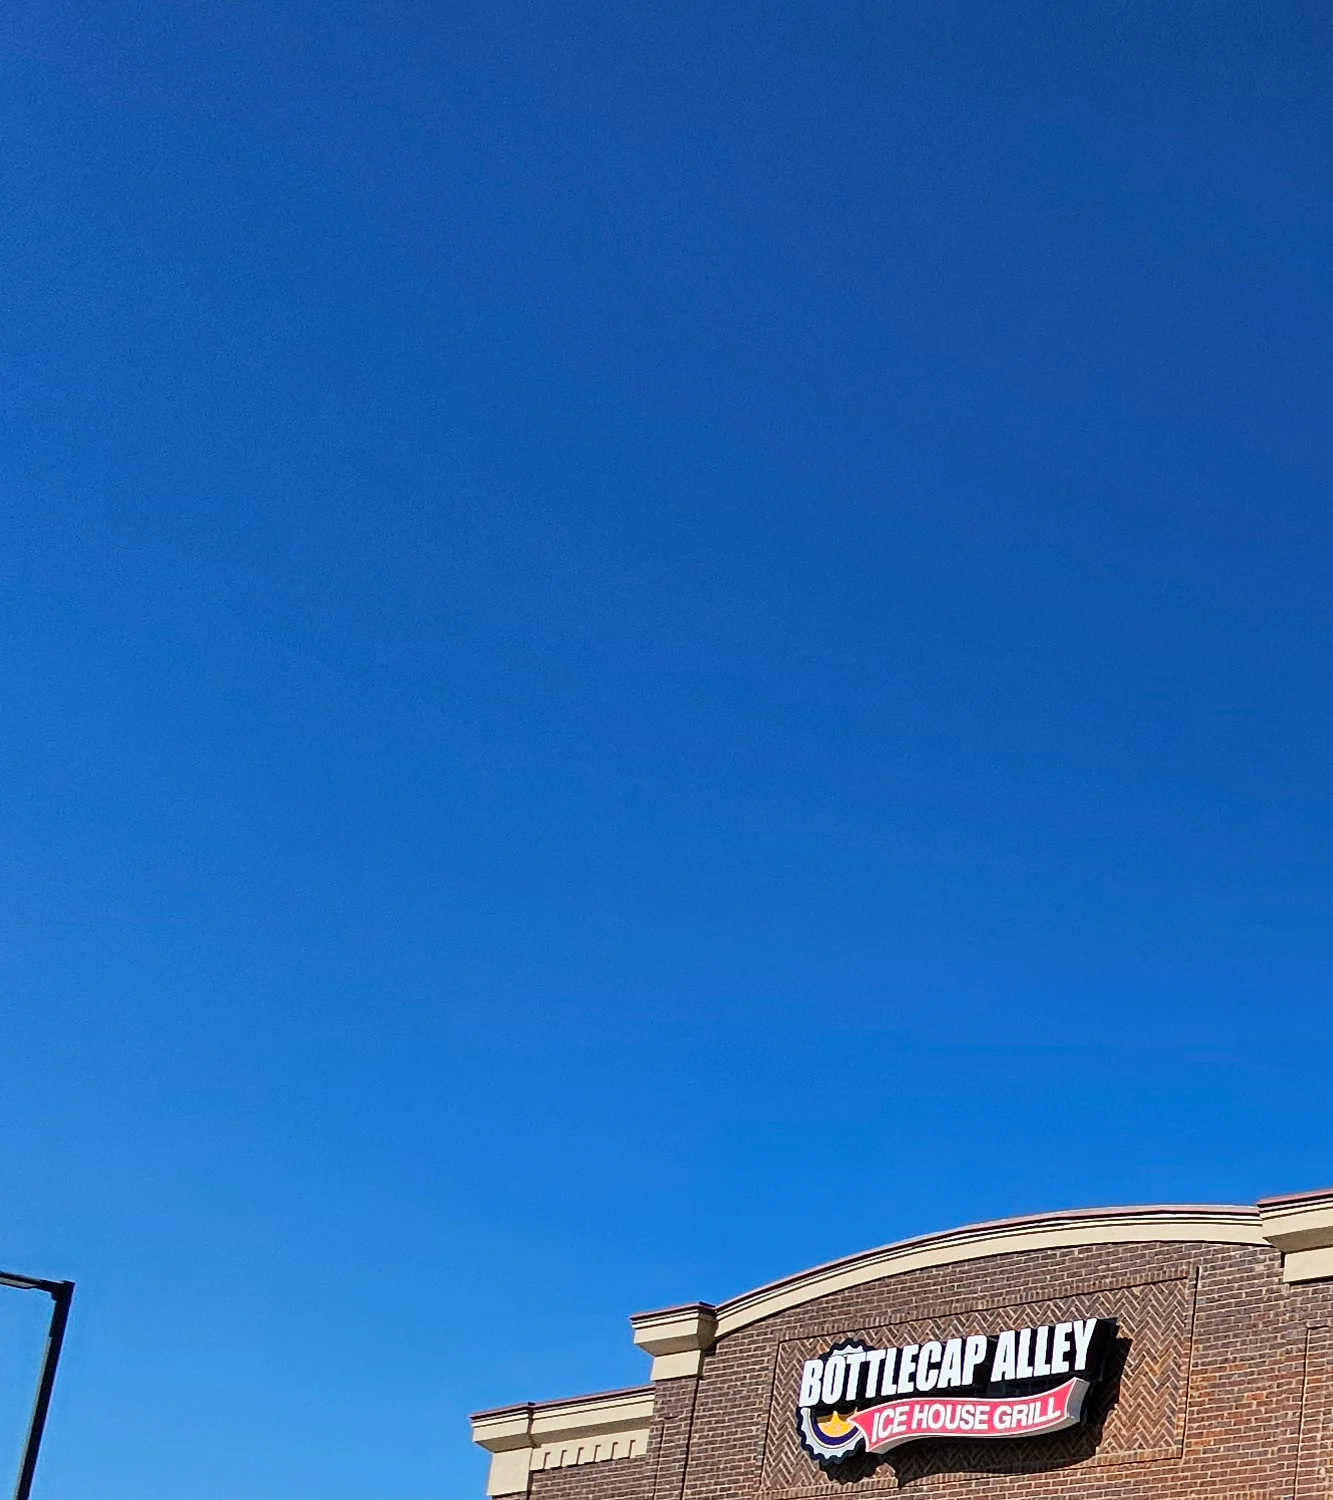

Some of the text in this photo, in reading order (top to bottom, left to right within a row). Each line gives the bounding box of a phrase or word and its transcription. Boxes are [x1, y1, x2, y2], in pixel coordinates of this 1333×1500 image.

[799, 1318, 1098, 1407] BOTTLECAP ALLEY
[871, 1396, 1062, 1443] ICE HOUSE GRILL
